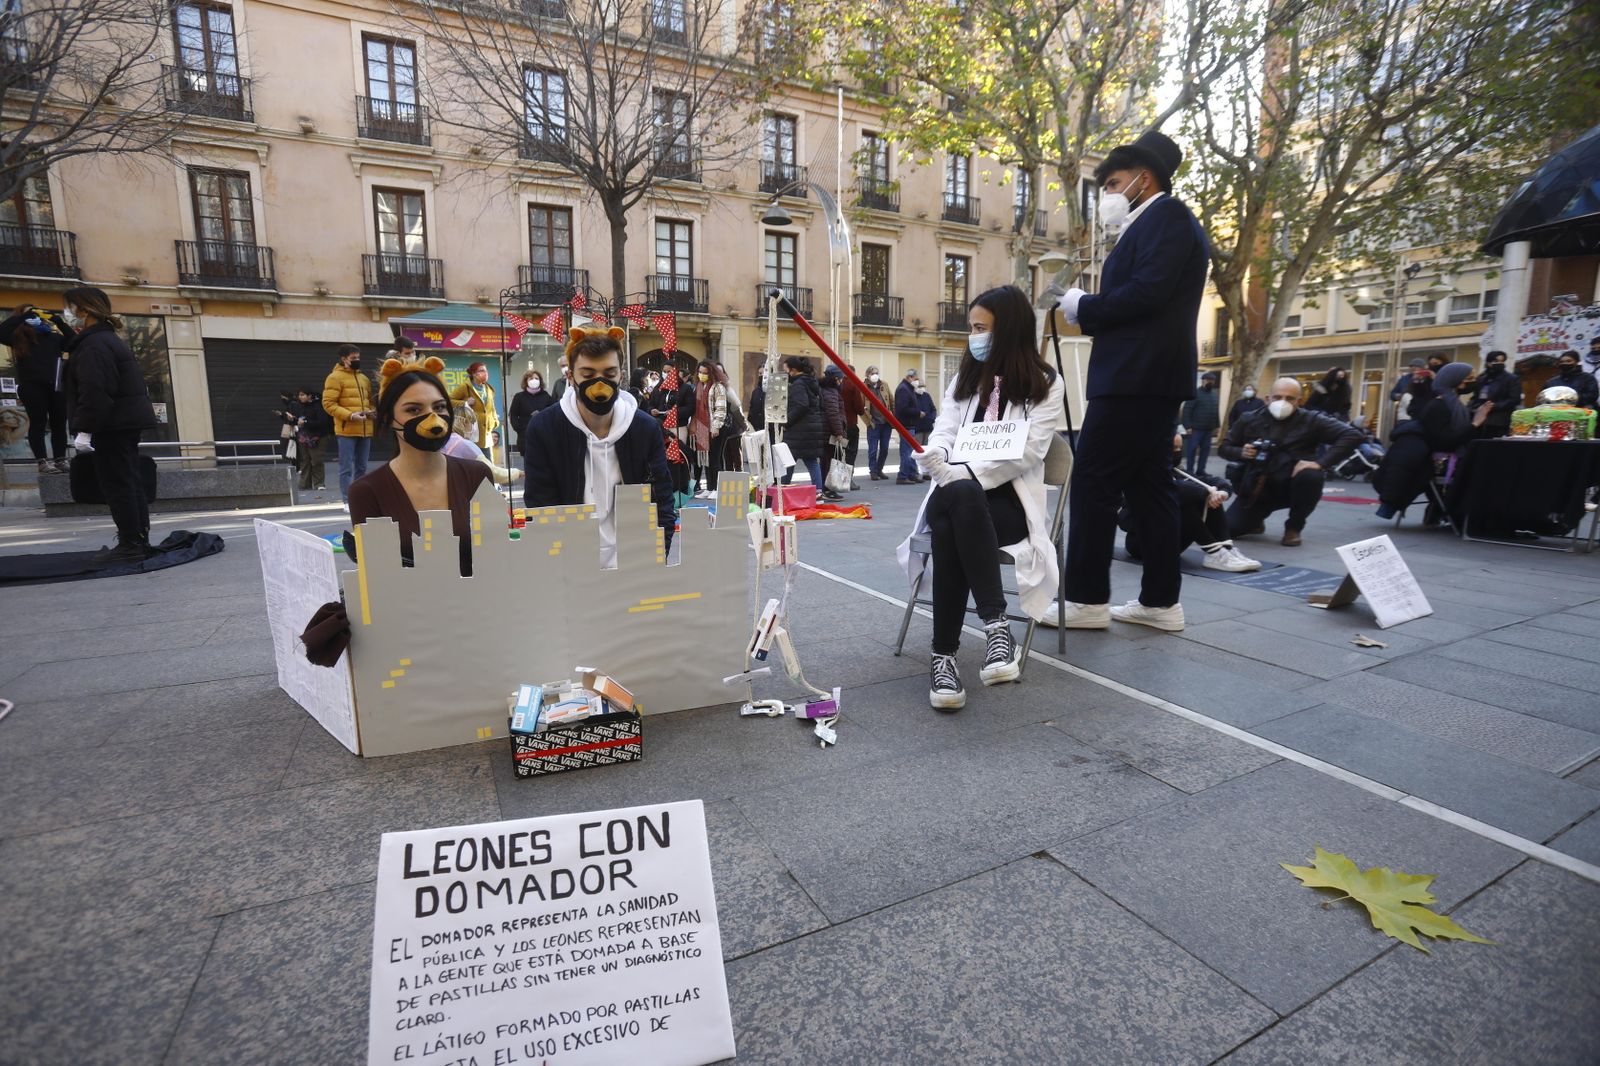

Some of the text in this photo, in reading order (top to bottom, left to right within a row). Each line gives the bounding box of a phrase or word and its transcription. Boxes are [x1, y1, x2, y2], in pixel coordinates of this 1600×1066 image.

[971, 422, 1017, 436] SANIDAD
[960, 438, 1011, 451] PÚBLICA
[545, 733, 567, 745] VANS
[594, 725, 614, 738] VANS
[527, 738, 551, 751] VANS
[560, 756, 582, 768] VANS
[573, 750, 595, 762] VANS
[612, 748, 633, 760] VANS
[520, 757, 543, 769] VANS
[403, 811, 671, 880] LEONES CON
[415, 858, 638, 919] DOMADOR
[390, 892, 678, 963] EL DOMADOR REPRESENTA LA SANIDAD
[423, 909, 701, 968] PÚBLICA Y LOS LEONES REPRESENTAN
[398, 931, 699, 991] A LA GENTE QUE ESTÁ DOMADA A BASE
[396, 948, 702, 1013] DE PASTILLAS SIN TENER UN DIAGNÓSTICO
[394, 987, 701, 1061] EL LÁTIGO FORMADO POR PASTILLAS
[395, 1011, 451, 1031] CLARO.
[494, 1047, 517, 1066] EL
[524, 1038, 557, 1058] USO
[563, 1020, 640, 1051] EXCESIVO
[650, 1014, 671, 1032] DE
